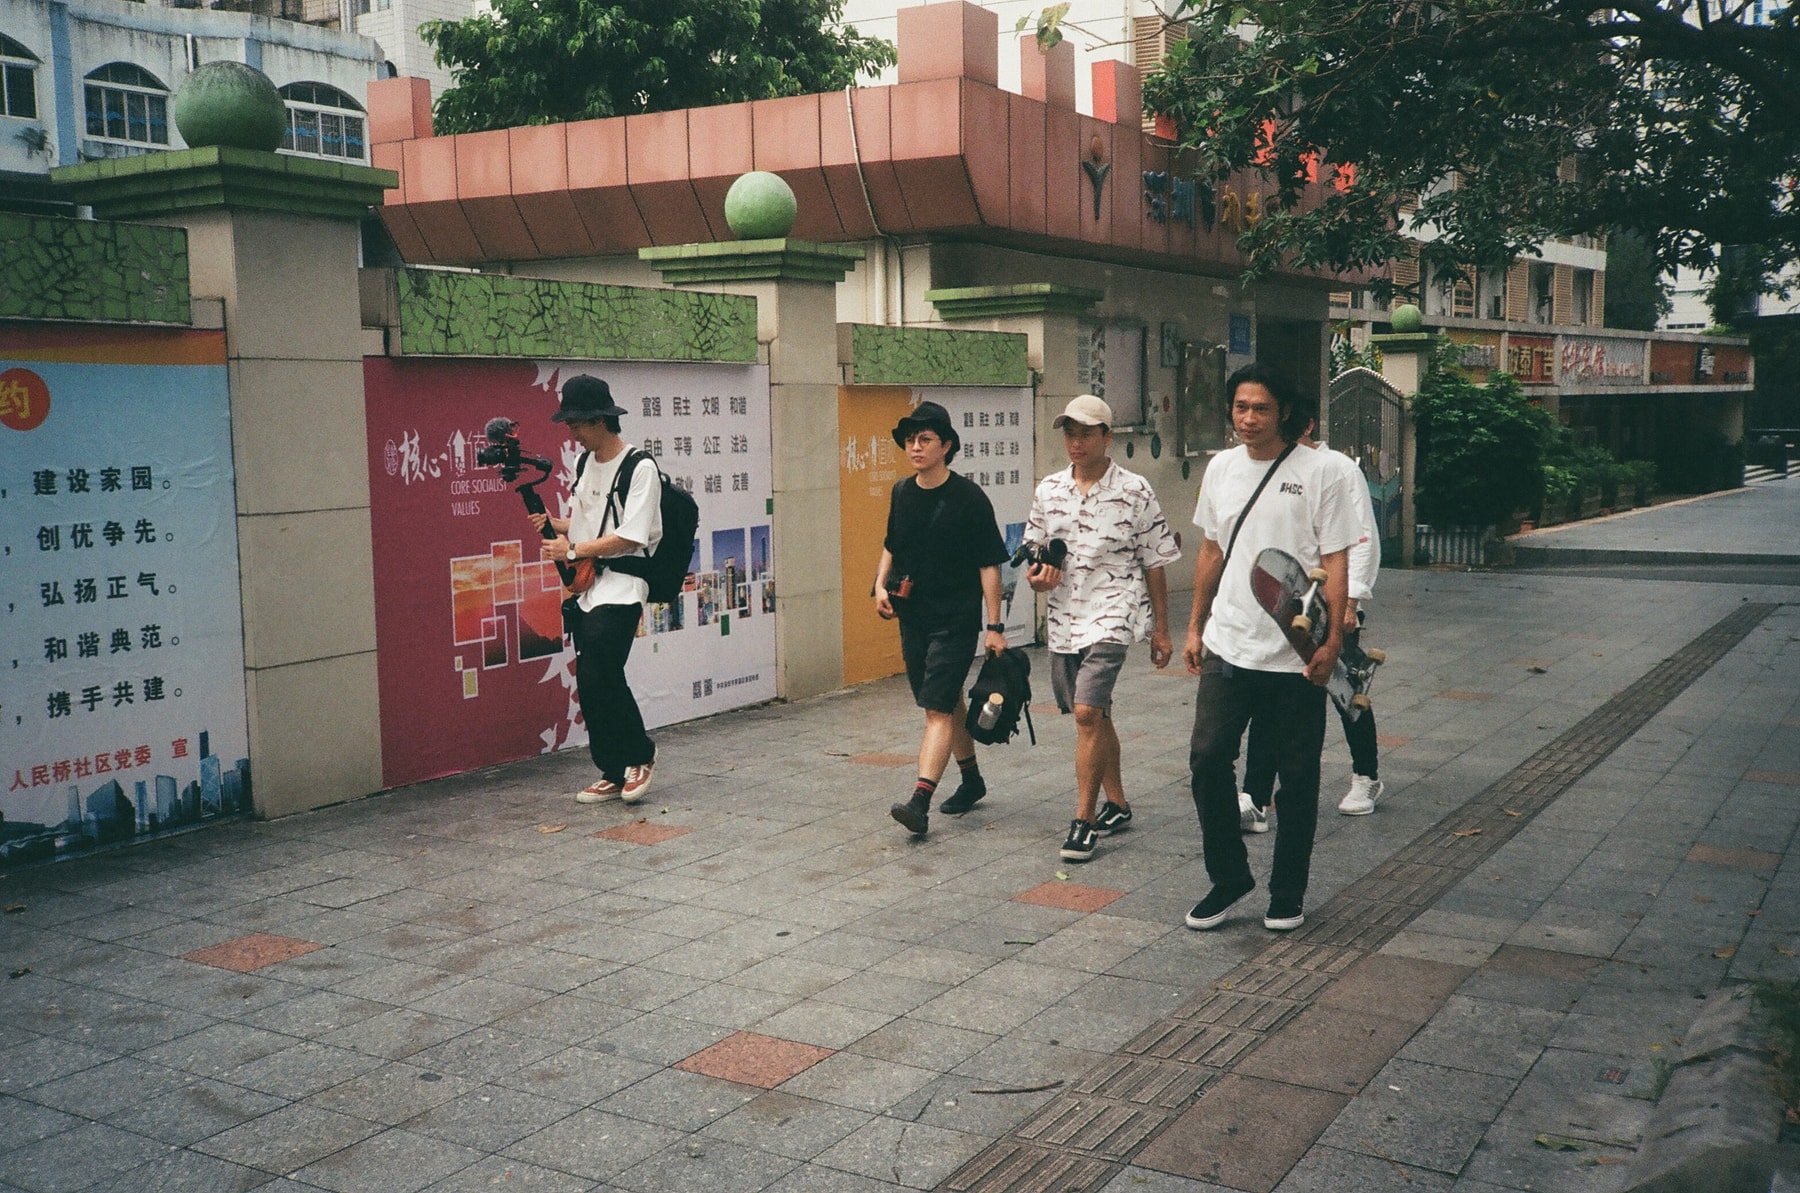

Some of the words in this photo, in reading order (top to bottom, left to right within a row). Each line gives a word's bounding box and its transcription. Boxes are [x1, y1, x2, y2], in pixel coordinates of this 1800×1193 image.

[0, 380, 30, 419] 约
[642, 396, 661, 417] 富强
[673, 396, 691, 416] 民主
[702, 396, 719, 415] 文明
[730, 396, 747, 415] 和谐
[644, 437, 662, 457] 自由
[674, 436, 692, 456] 平等
[703, 436, 721, 455] 公正
[731, 434, 748, 454] 法治
[451, 480, 470, 495] CORE
[472, 478, 507, 494] SOCIALIST
[704, 474, 722, 493] 诚信
[732, 472, 749, 492] 友善
[451, 500, 480, 516] VALUES
[9, 745, 151, 792] 人民桥社区党委
[171, 738, 189, 758] 宣
